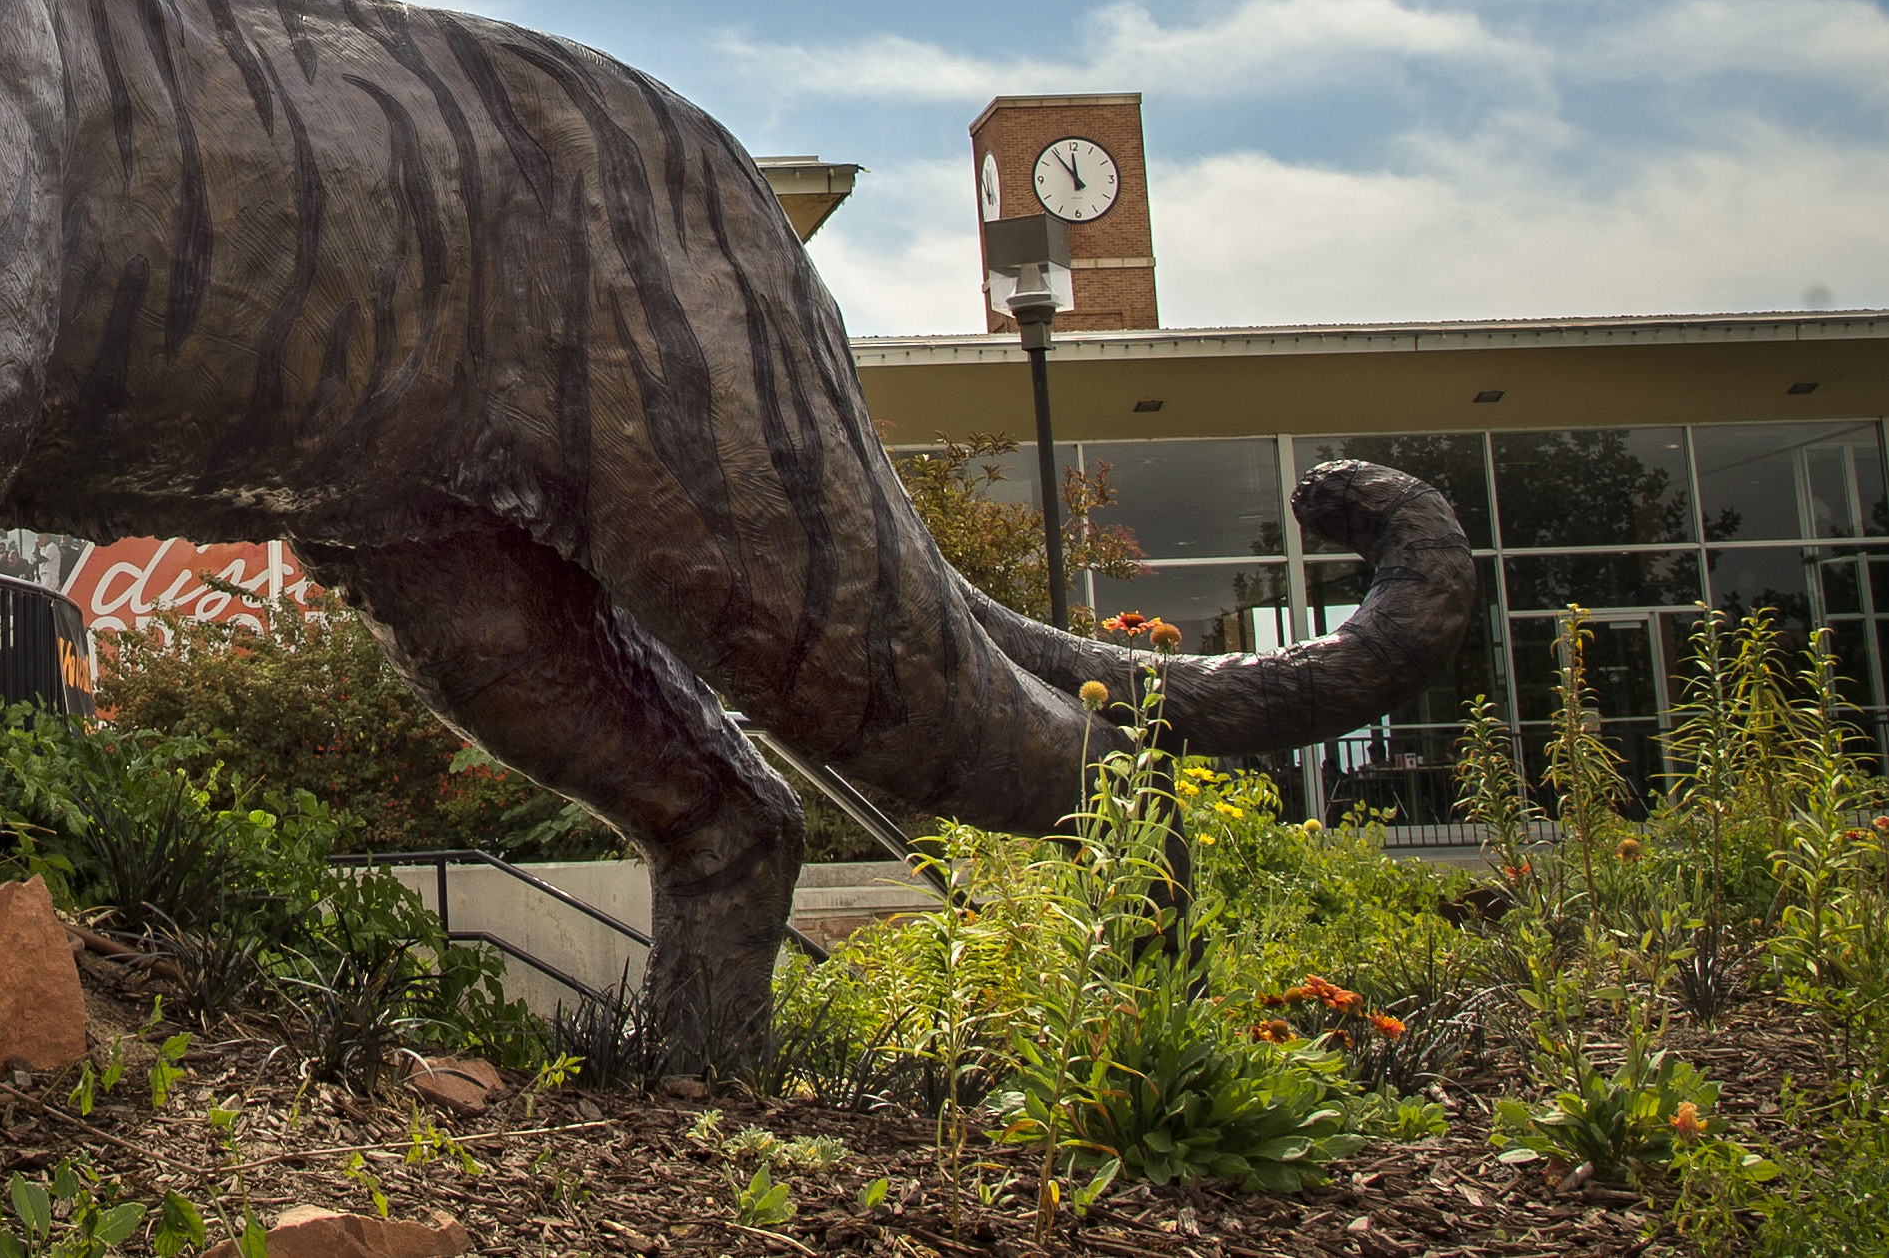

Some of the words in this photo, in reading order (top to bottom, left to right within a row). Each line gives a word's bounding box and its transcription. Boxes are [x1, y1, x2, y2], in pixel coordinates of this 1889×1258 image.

[1068, 141, 1079, 152] 12
[1037, 175, 1045, 185] 9
[1107, 174, 1115, 185] 3
[1074, 209, 1082, 219] 6
